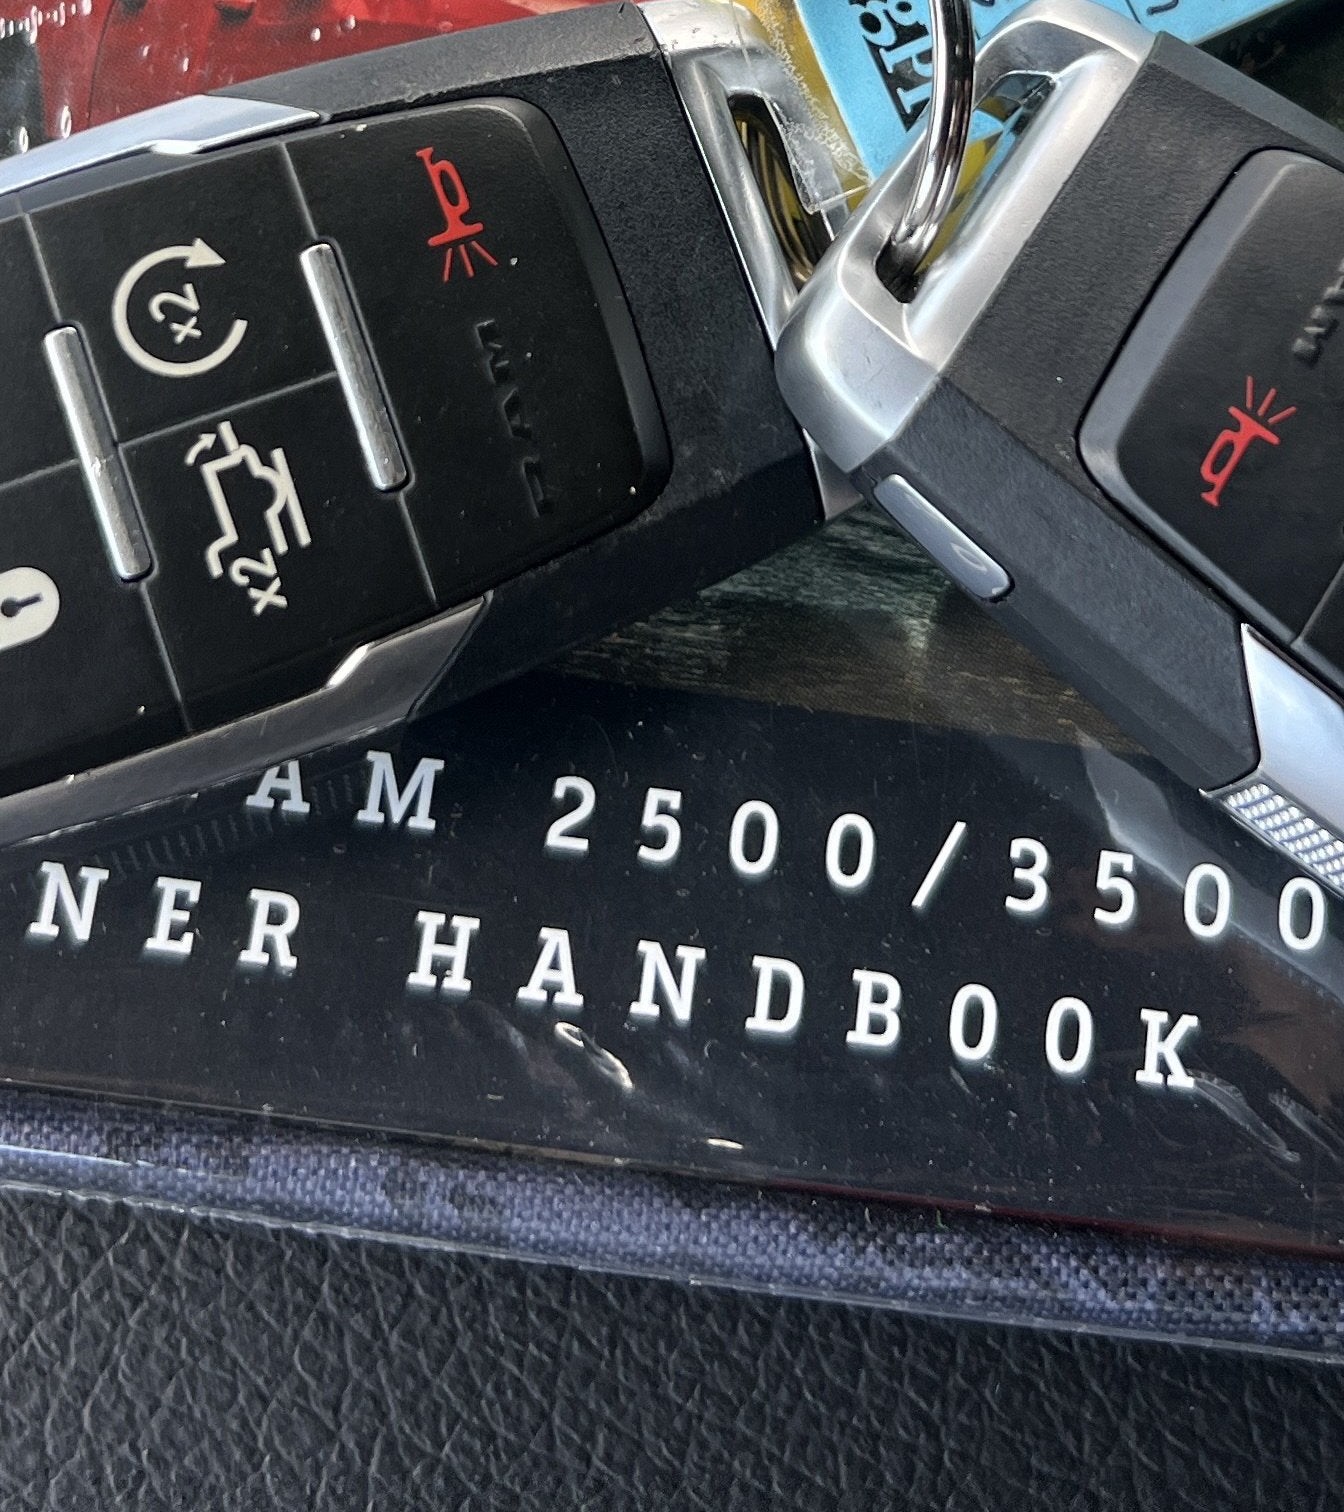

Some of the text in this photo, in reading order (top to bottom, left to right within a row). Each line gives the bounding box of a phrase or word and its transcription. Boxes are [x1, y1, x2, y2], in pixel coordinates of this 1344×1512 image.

[245, 749, 1327, 952] AM 2500/3500
[406, 910, 1201, 1088] HANDBOOK
